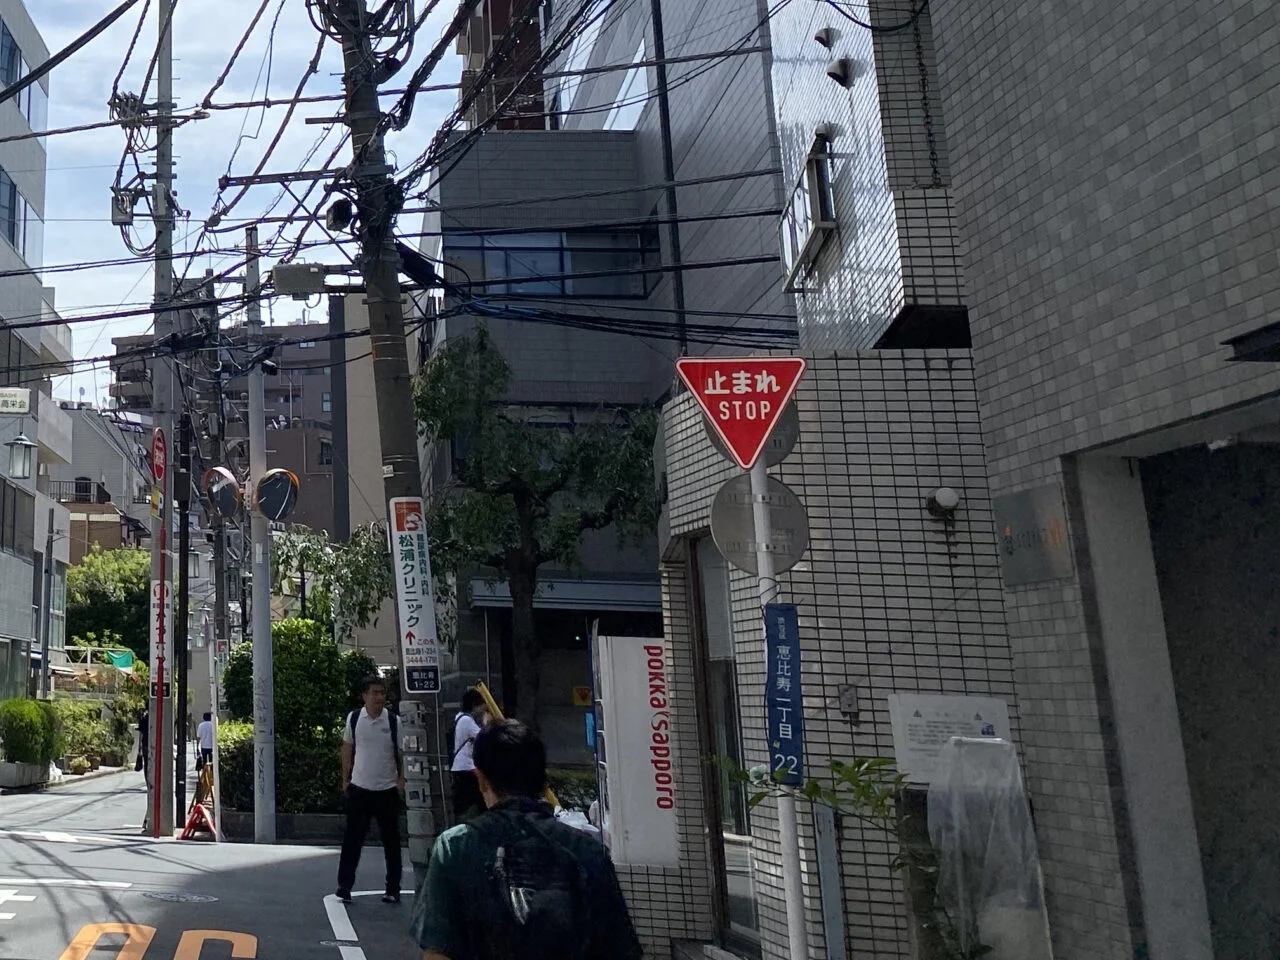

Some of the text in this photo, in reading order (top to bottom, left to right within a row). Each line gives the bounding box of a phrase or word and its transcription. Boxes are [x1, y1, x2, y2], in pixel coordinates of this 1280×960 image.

[704, 369, 781, 395] 止まれ
[719, 400, 771, 420] STOP
[398, 534, 423, 628] 松浦クリニック
[775, 644, 793, 740] 恵比寿一丁目
[643, 645, 675, 810] pokka sapporo
[773, 752, 799, 776] 22
